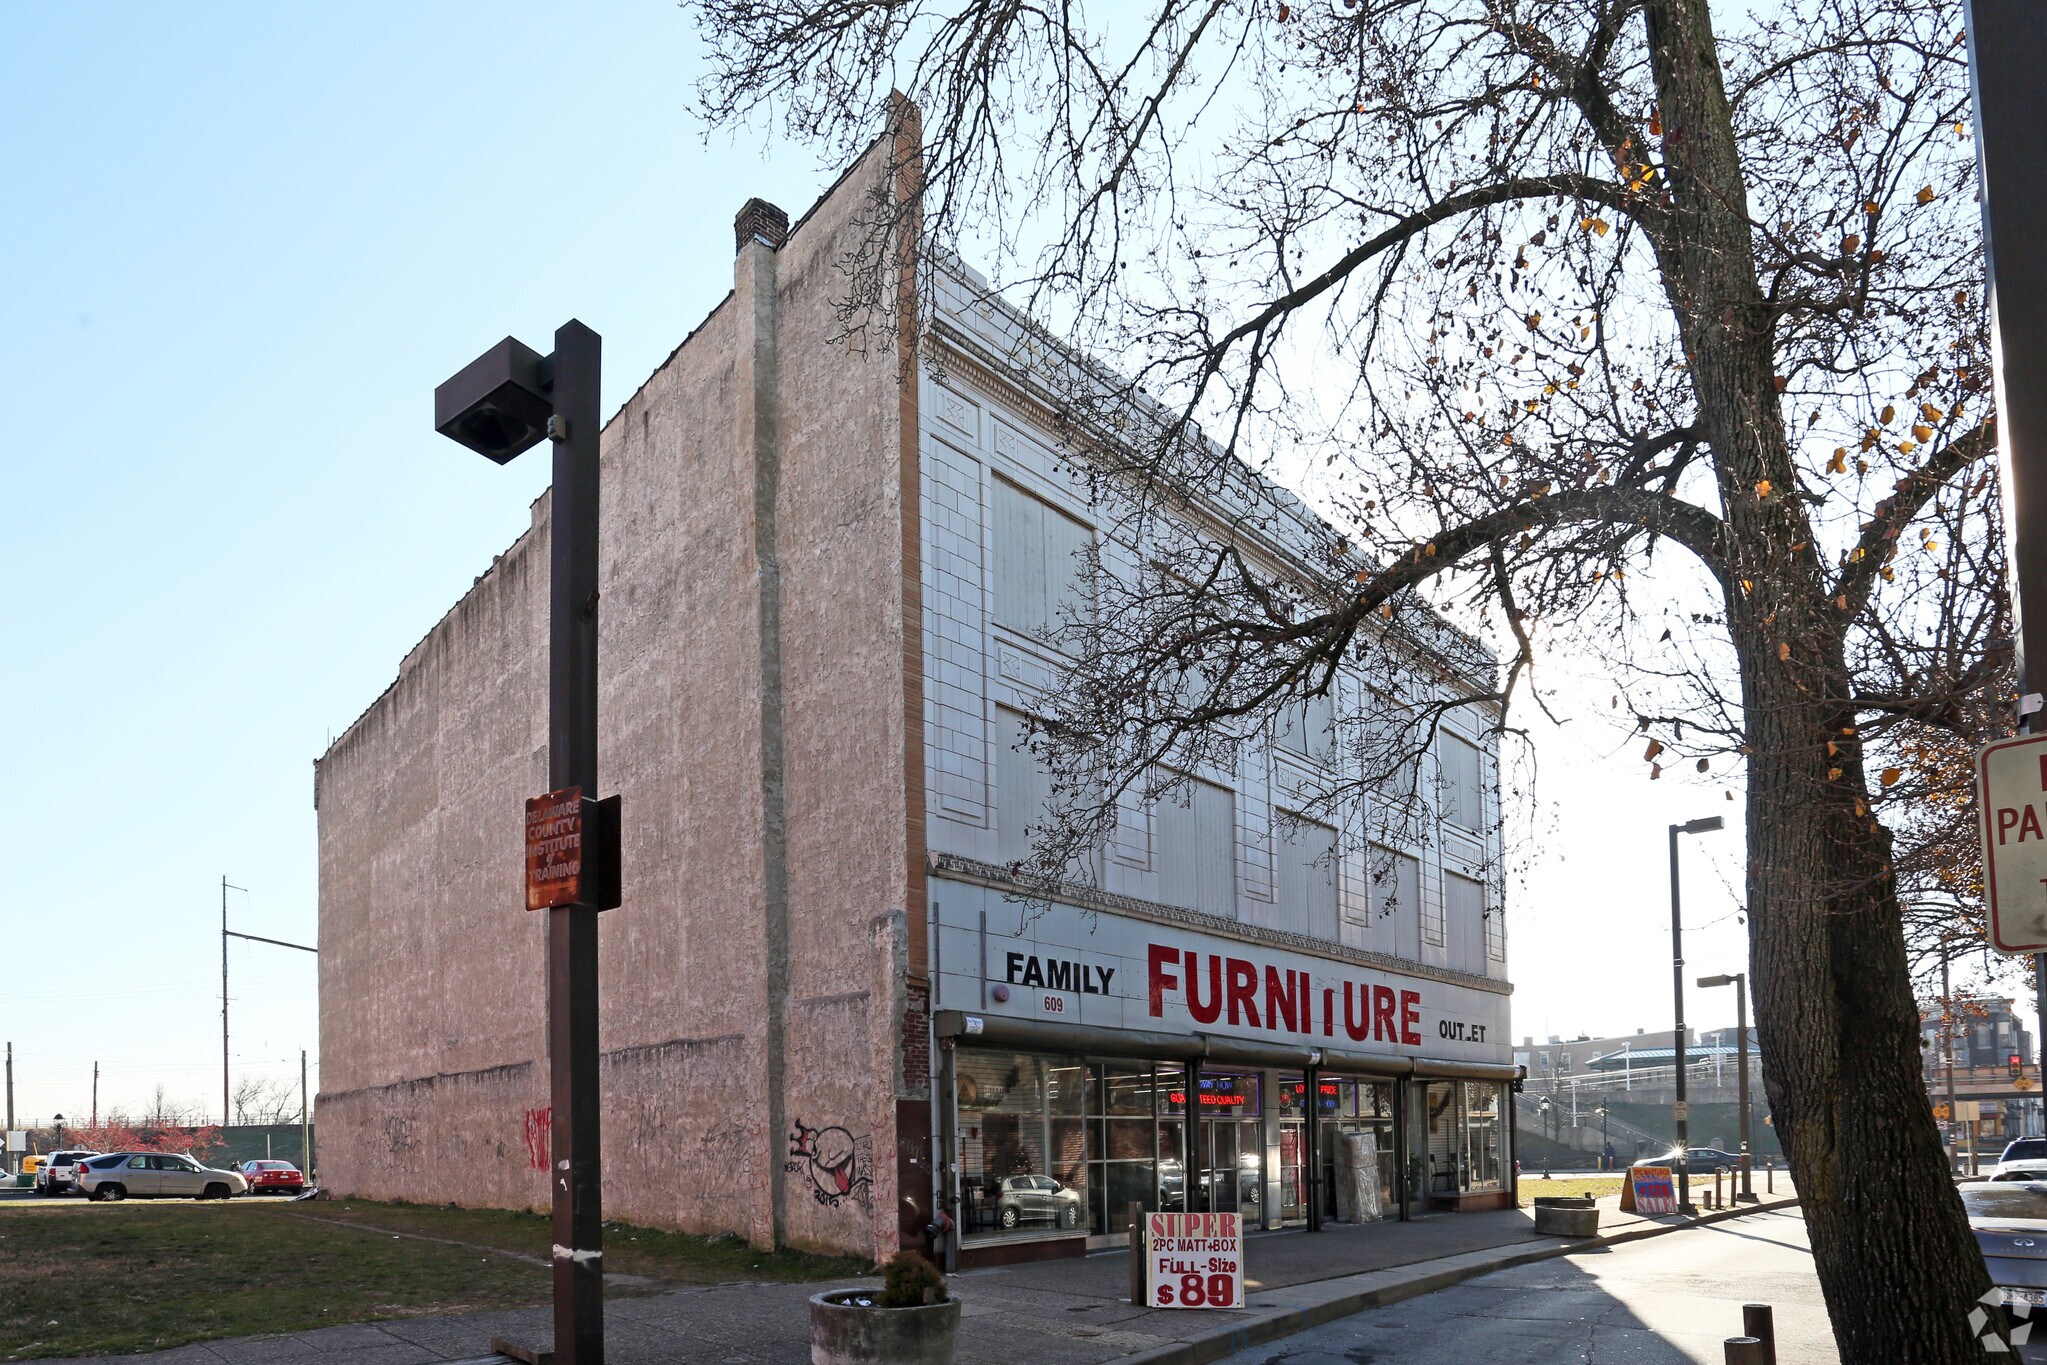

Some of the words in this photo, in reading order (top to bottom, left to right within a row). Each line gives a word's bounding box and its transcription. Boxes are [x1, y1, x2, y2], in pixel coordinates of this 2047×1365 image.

[526, 800, 580, 826] DELAWARE
[1998, 804, 2047, 845] PA
[528, 817, 575, 840] COUNTY
[526, 833, 580, 858] INSTITUTE
[528, 860, 580, 884] TRAINING
[1007, 952, 1115, 995] FAMILY
[1439, 1020, 1486, 1043] OUTET
[1044, 996, 1063, 1012] 609
[1170, 1093, 1216, 1105] GUATEED
[1217, 1096, 1245, 1105] QUALITY
[1320, 1085, 1337, 1095] PRICE
[1151, 1214, 1237, 1238] SUPER
[1153, 1239, 1174, 1252] 2PC
[1178, 1239, 1237, 1252] MATT+BOX
[1157, 1274, 1233, 1307] $89
